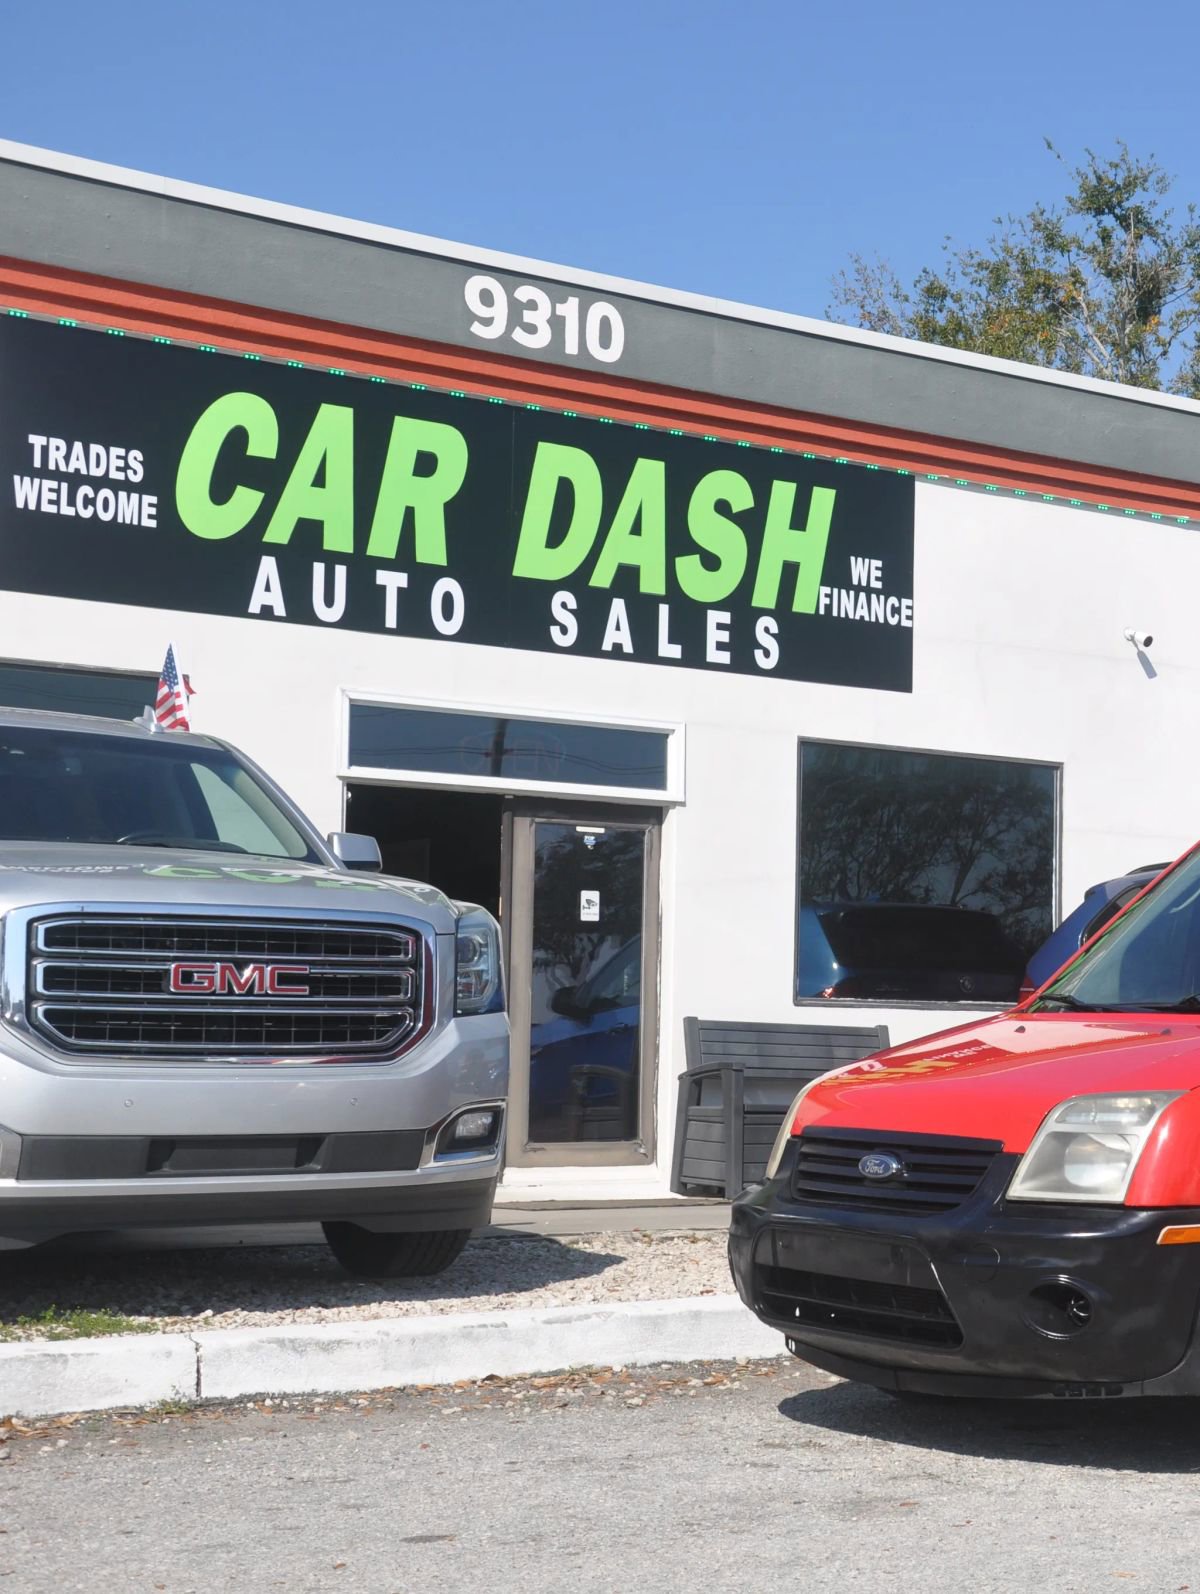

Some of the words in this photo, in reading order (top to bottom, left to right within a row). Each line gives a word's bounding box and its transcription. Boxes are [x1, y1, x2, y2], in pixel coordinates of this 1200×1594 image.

[464, 275, 625, 363] 9310
[28, 434, 144, 483] TRADES
[13, 475, 158, 528] WELCOME
[175, 391, 469, 566] CAR
[512, 441, 837, 615] DASH
[850, 555, 883, 589] WE
[247, 555, 465, 636] AUTO
[550, 590, 780, 670] SALES
[818, 586, 913, 628] FINANCE
[170, 962, 309, 995] GMC
